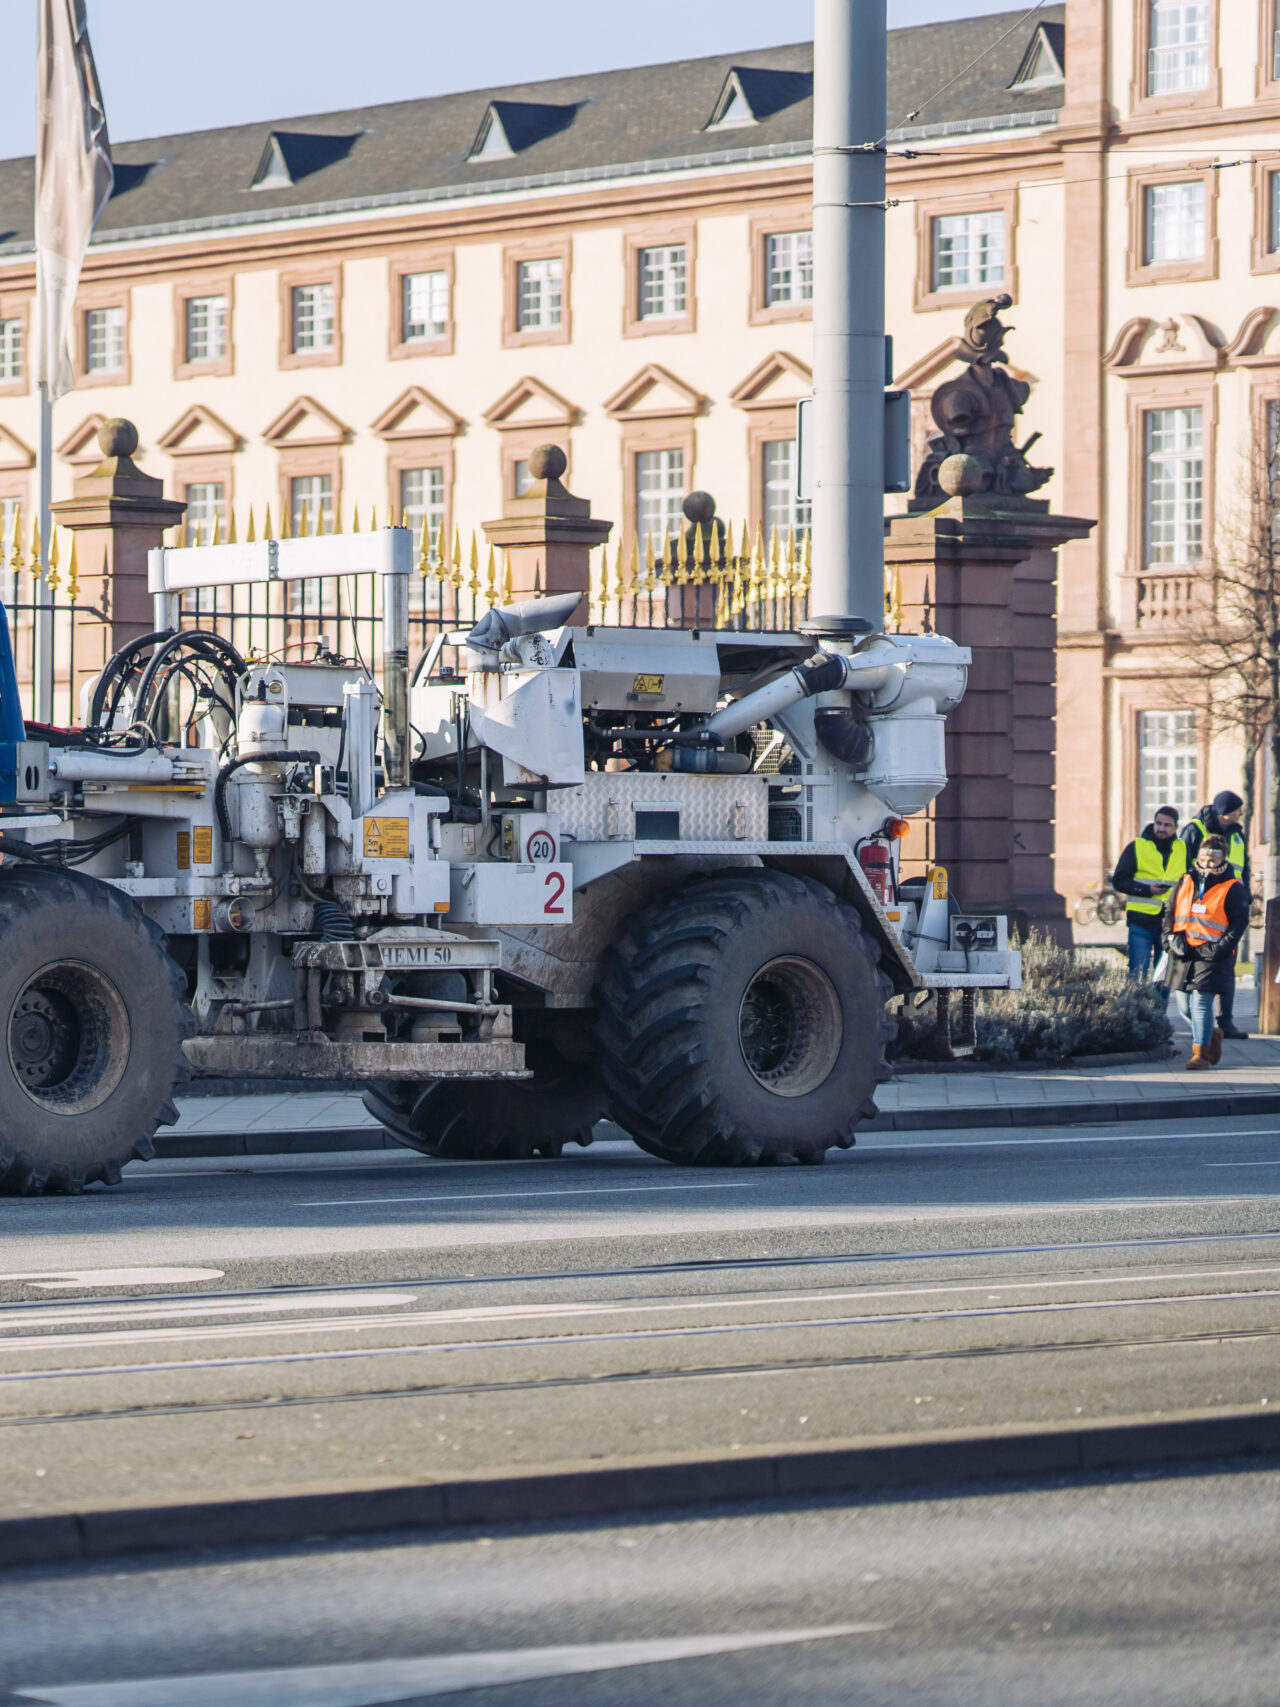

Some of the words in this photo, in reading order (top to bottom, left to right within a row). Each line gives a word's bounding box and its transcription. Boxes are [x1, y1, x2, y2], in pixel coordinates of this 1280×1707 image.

[533, 840, 549, 858] 20
[543, 871, 565, 913] 2
[380, 947, 428, 964] HEMI
[433, 947, 452, 964] 50
